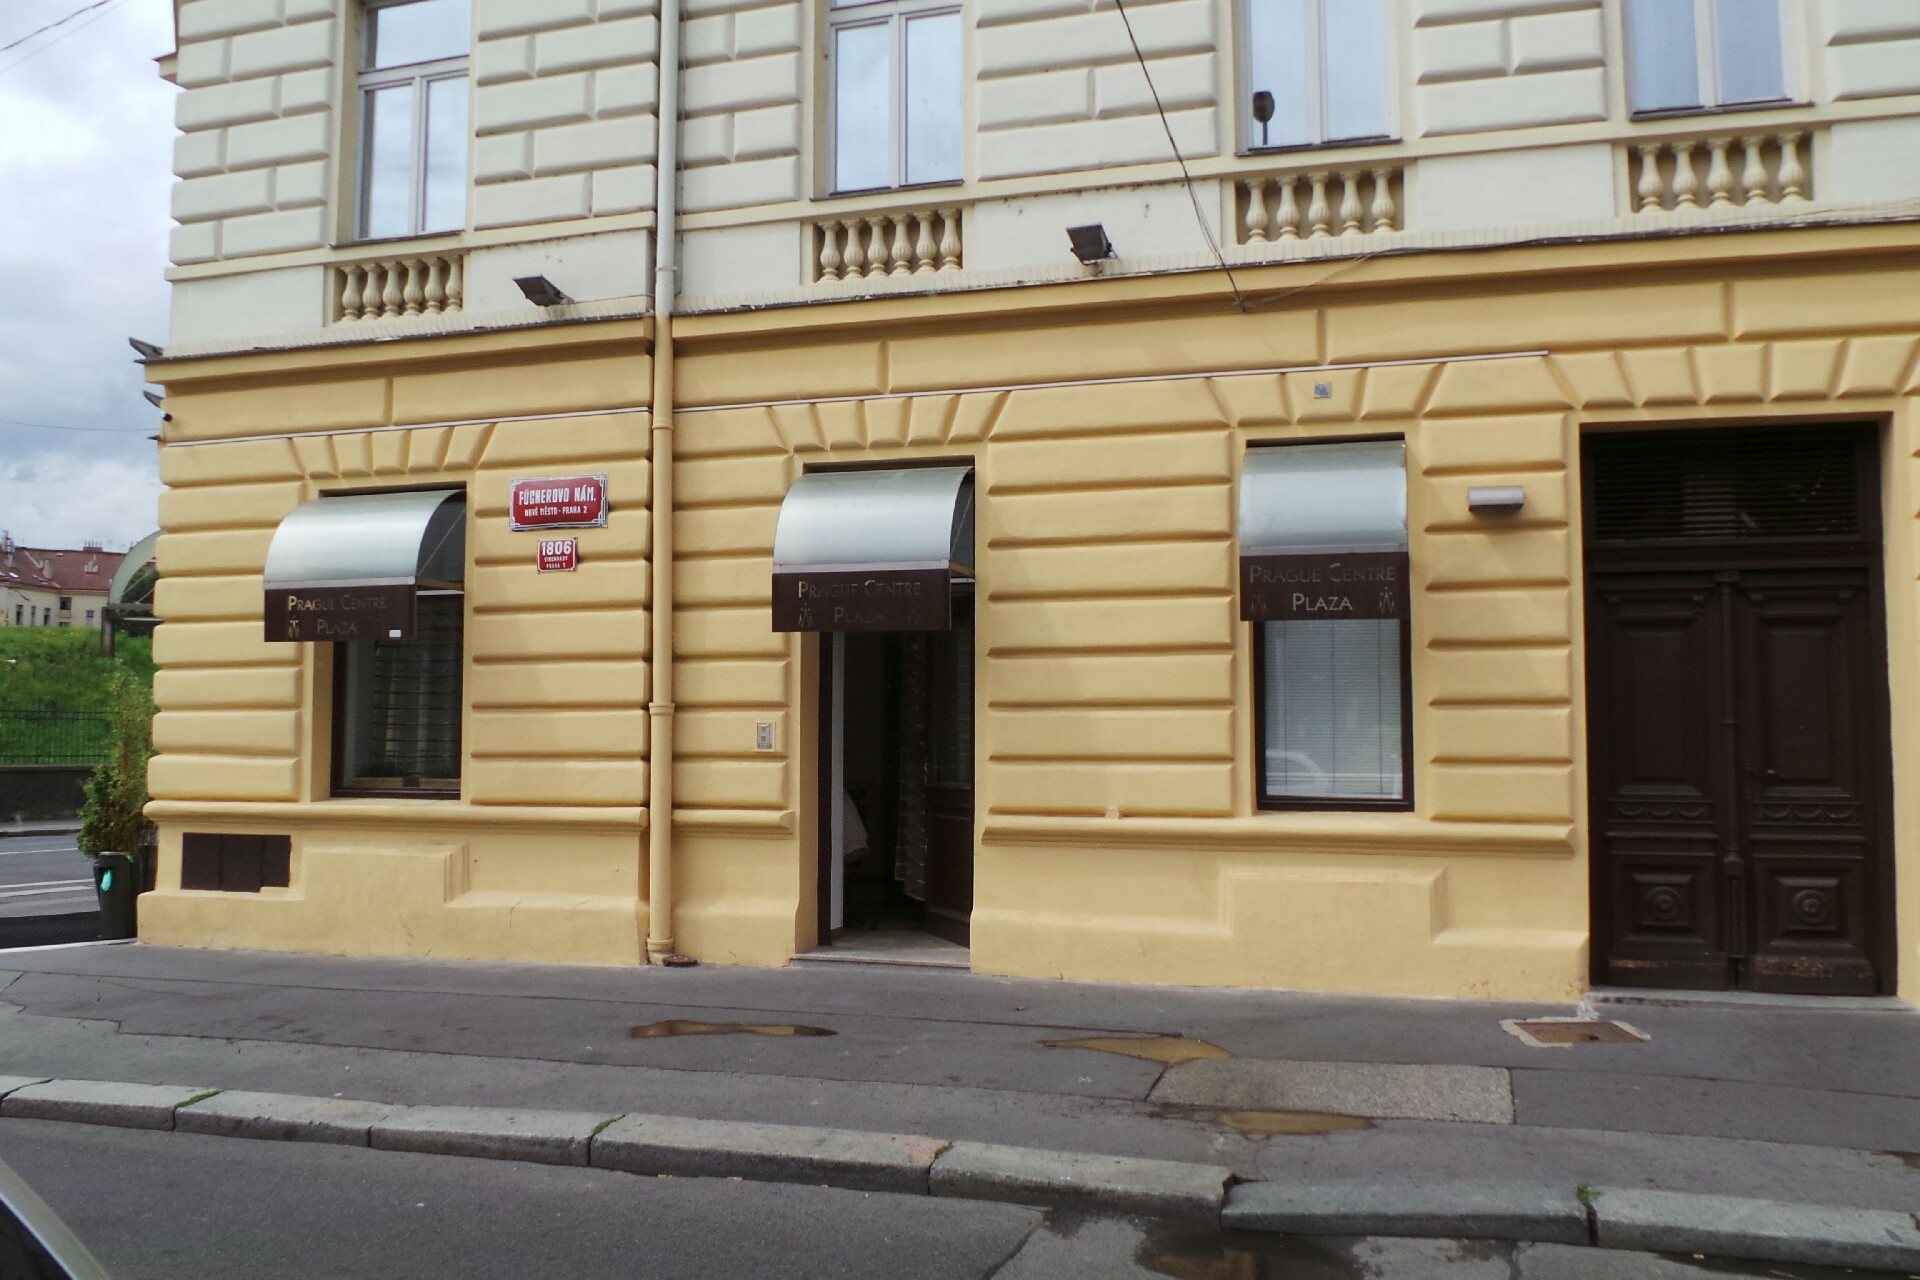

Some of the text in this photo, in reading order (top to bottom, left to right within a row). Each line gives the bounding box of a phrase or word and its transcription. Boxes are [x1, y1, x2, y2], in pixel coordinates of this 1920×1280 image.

[519, 484, 597, 505] FÜGNEROVO NÁM.
[524, 506, 539, 517] NOVÉ
[540, 505, 558, 516] MĚSTO
[562, 506, 581, 515] PRAHA
[583, 505, 588, 514] 2
[541, 540, 572, 556] 1806
[1249, 562, 1397, 584] PRAGUE CENTRE
[798, 580, 921, 598] PRAGUE CENTRE
[287, 594, 387, 611] PRAGUE CENTRE
[1292, 592, 1353, 611] PLAZA
[834, 606, 885, 624] PLAZA
[316, 618, 358, 634] PLAZA
